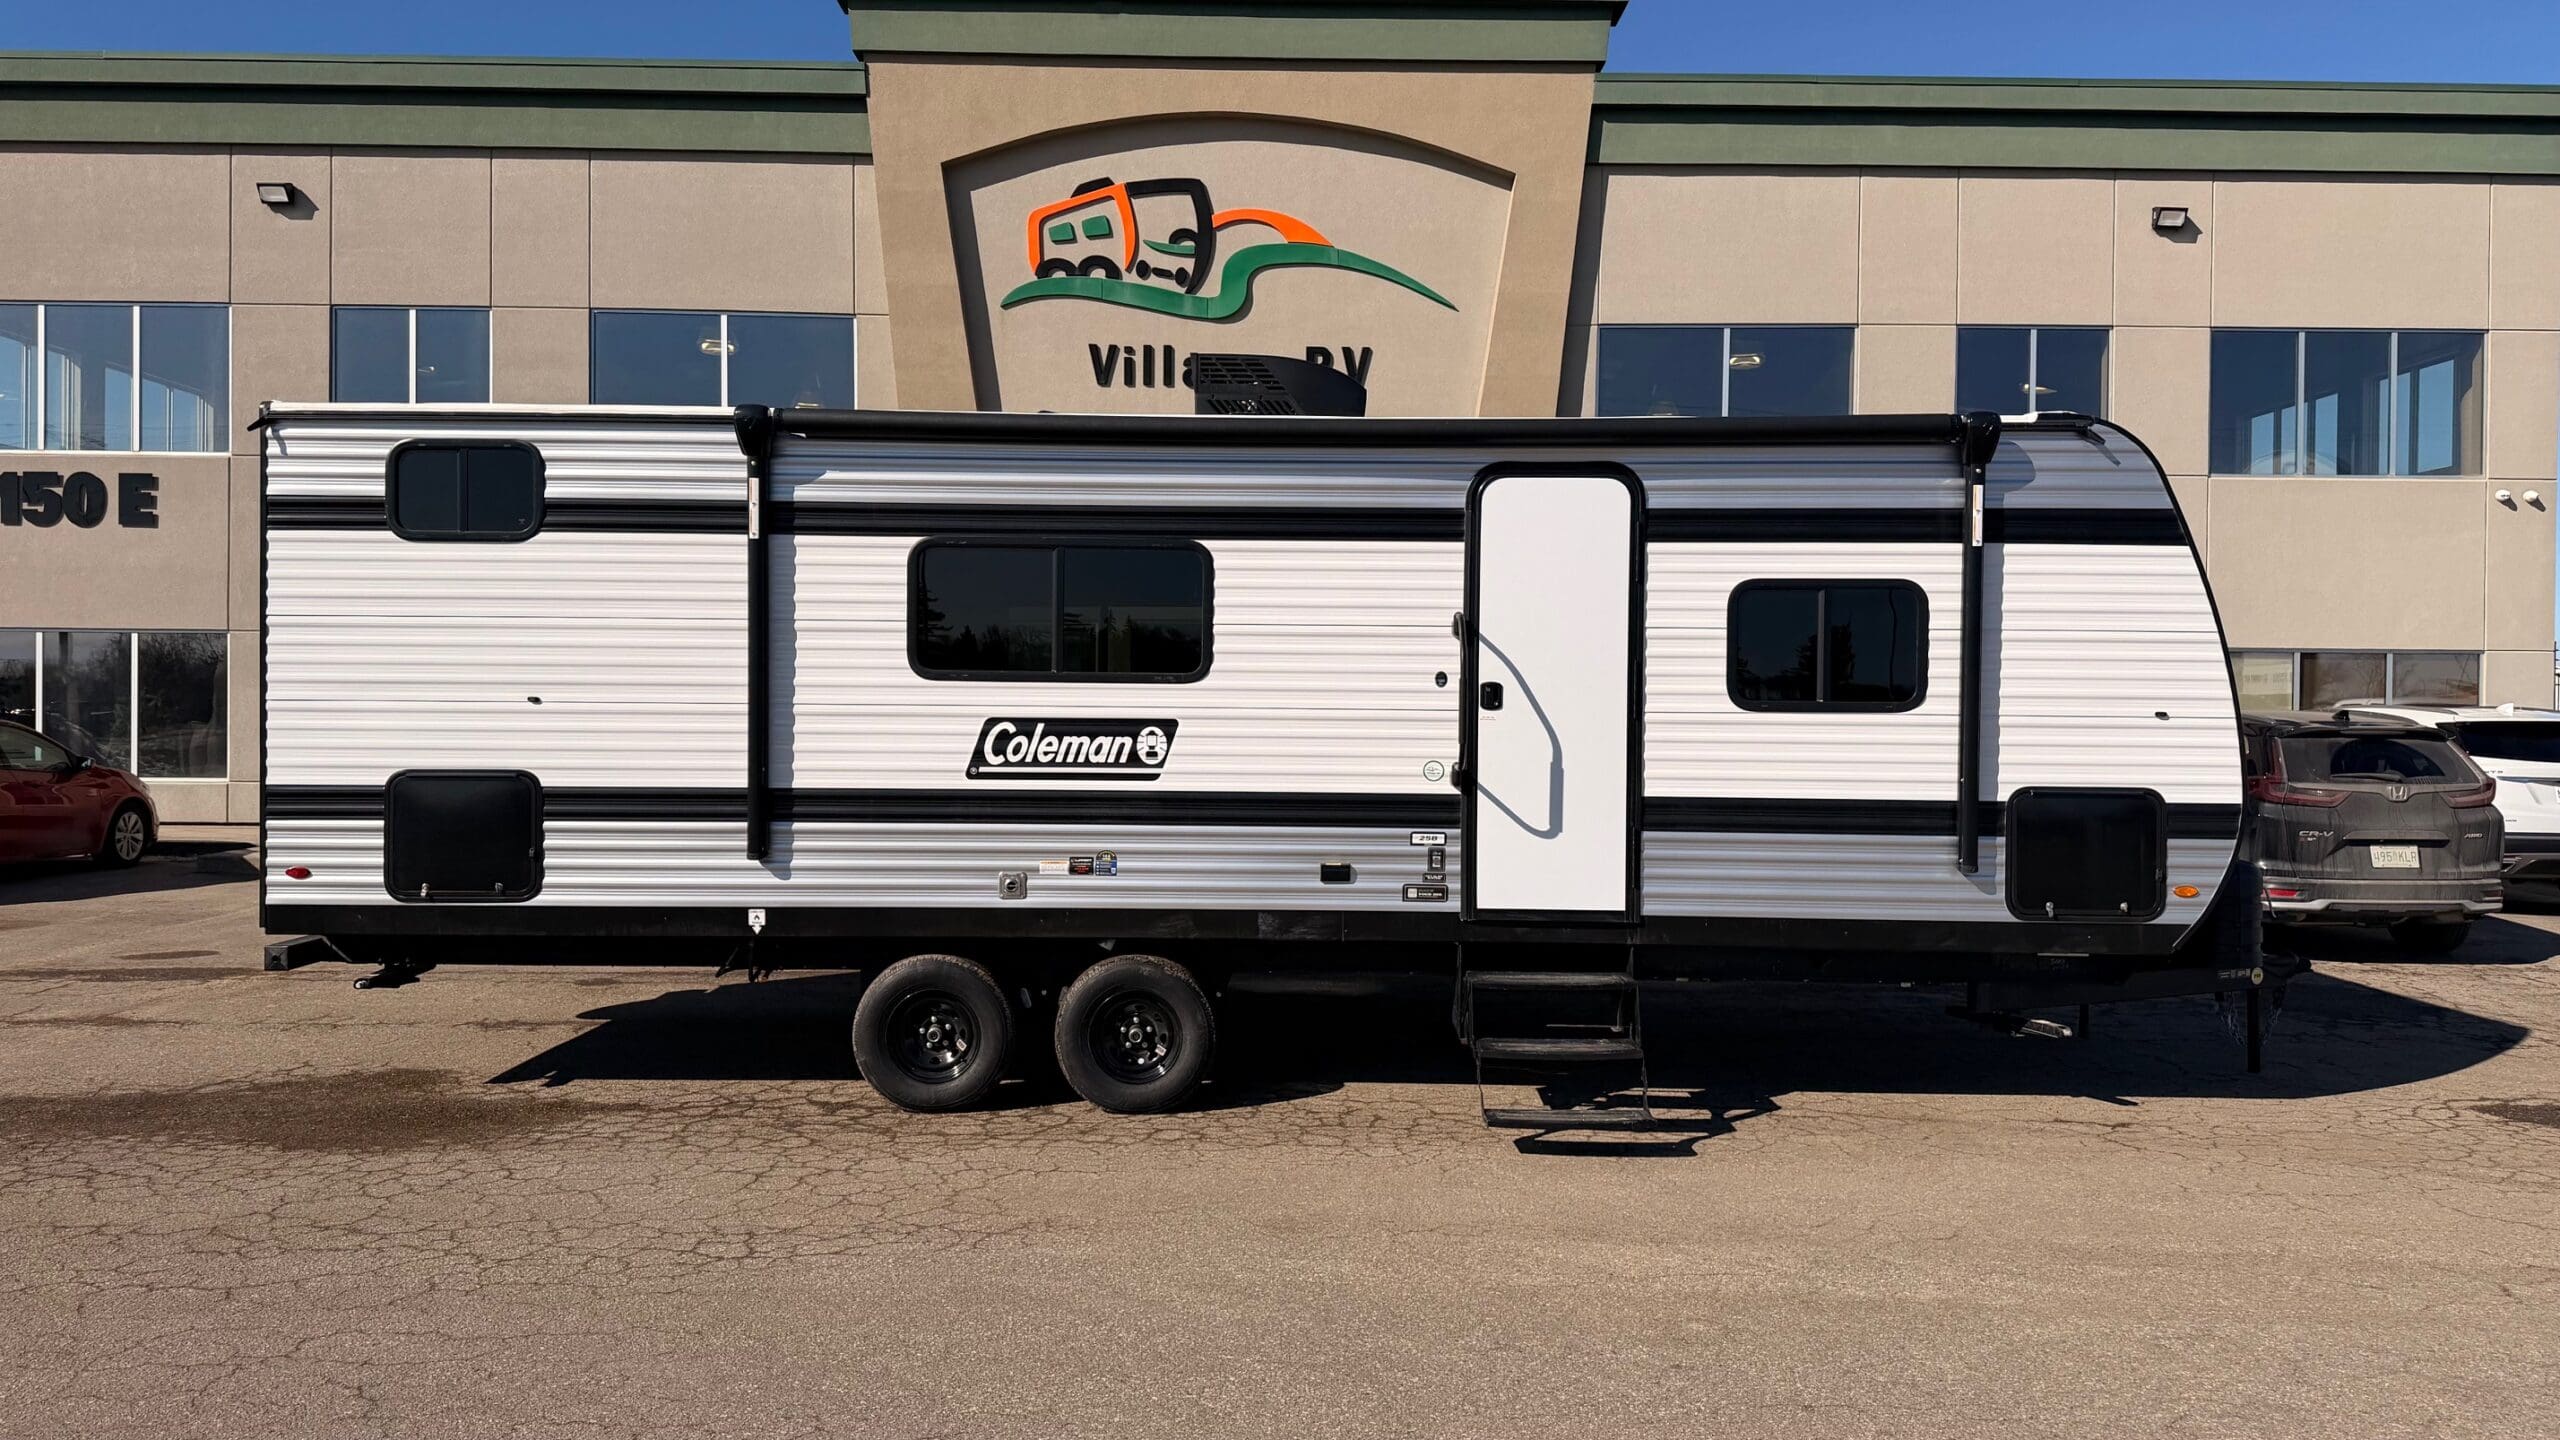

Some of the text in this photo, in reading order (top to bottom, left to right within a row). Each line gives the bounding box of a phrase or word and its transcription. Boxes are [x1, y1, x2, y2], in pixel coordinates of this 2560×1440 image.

[1088, 343, 1196, 390] Vill
[0, 471, 159, 528] 150 E
[983, 721, 1134, 766] Coleman
[2298, 830, 2334, 838] CR-V
[2374, 850, 2393, 863] 495
